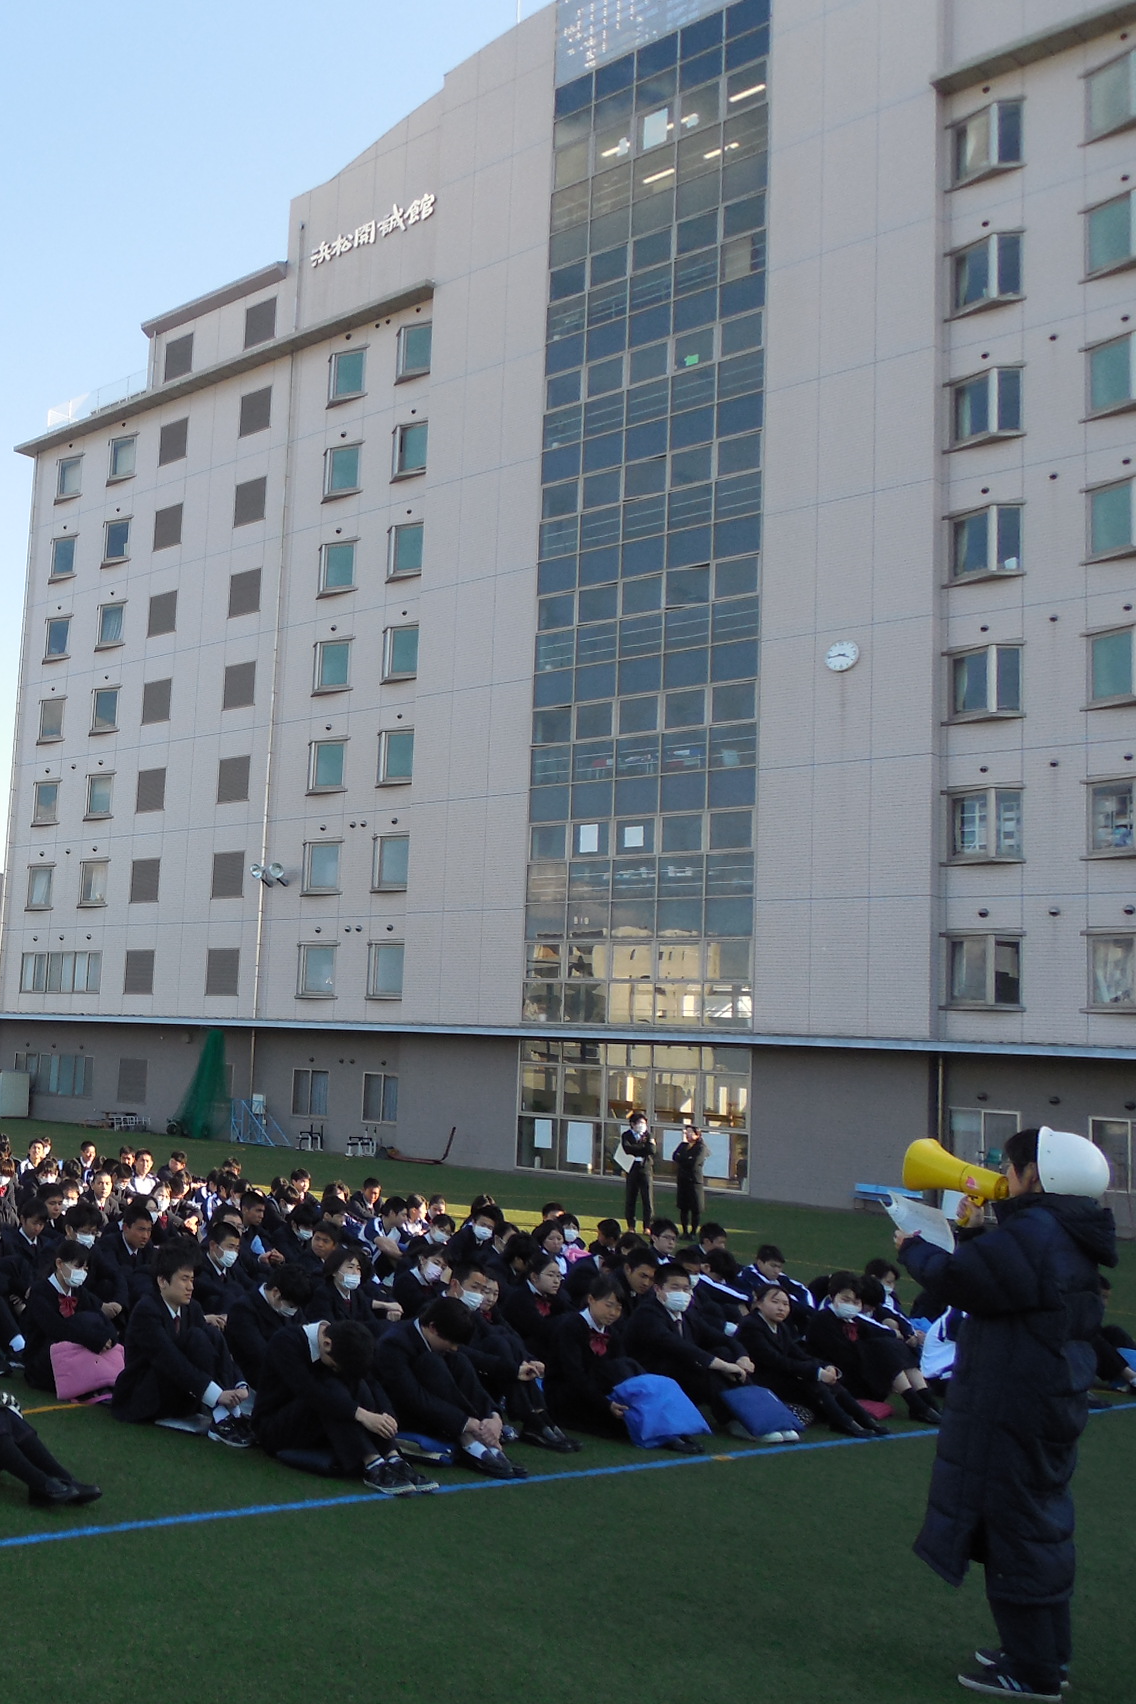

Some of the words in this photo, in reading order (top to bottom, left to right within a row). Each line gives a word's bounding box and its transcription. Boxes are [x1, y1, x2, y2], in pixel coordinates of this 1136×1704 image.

[310, 192, 436, 267] 浜松開誠館
